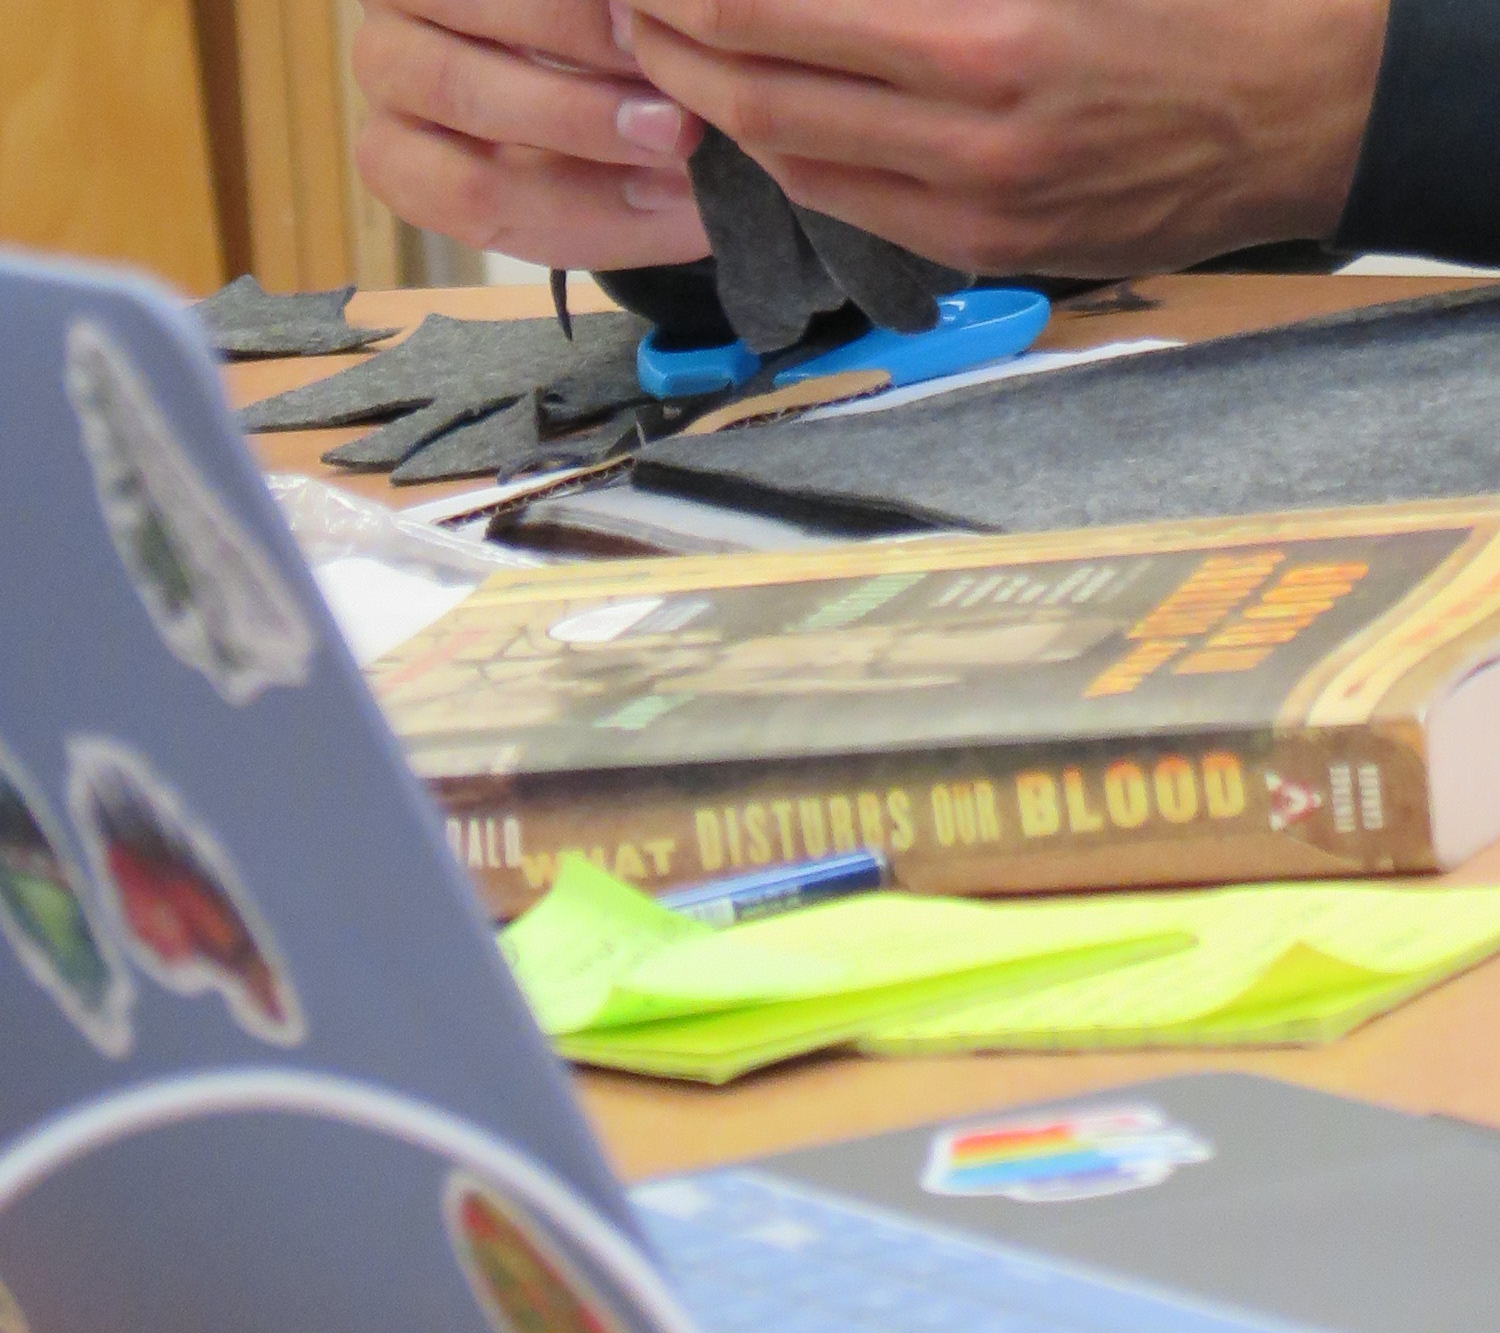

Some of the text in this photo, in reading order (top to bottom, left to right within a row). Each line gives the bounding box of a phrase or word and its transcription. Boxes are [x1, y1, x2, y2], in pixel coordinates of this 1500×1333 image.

[522, 836, 676, 889] WAT
[694, 786, 915, 871] DISTURBS
[931, 777, 1000, 848] OUR
[1015, 749, 1246, 839] BLOOD
